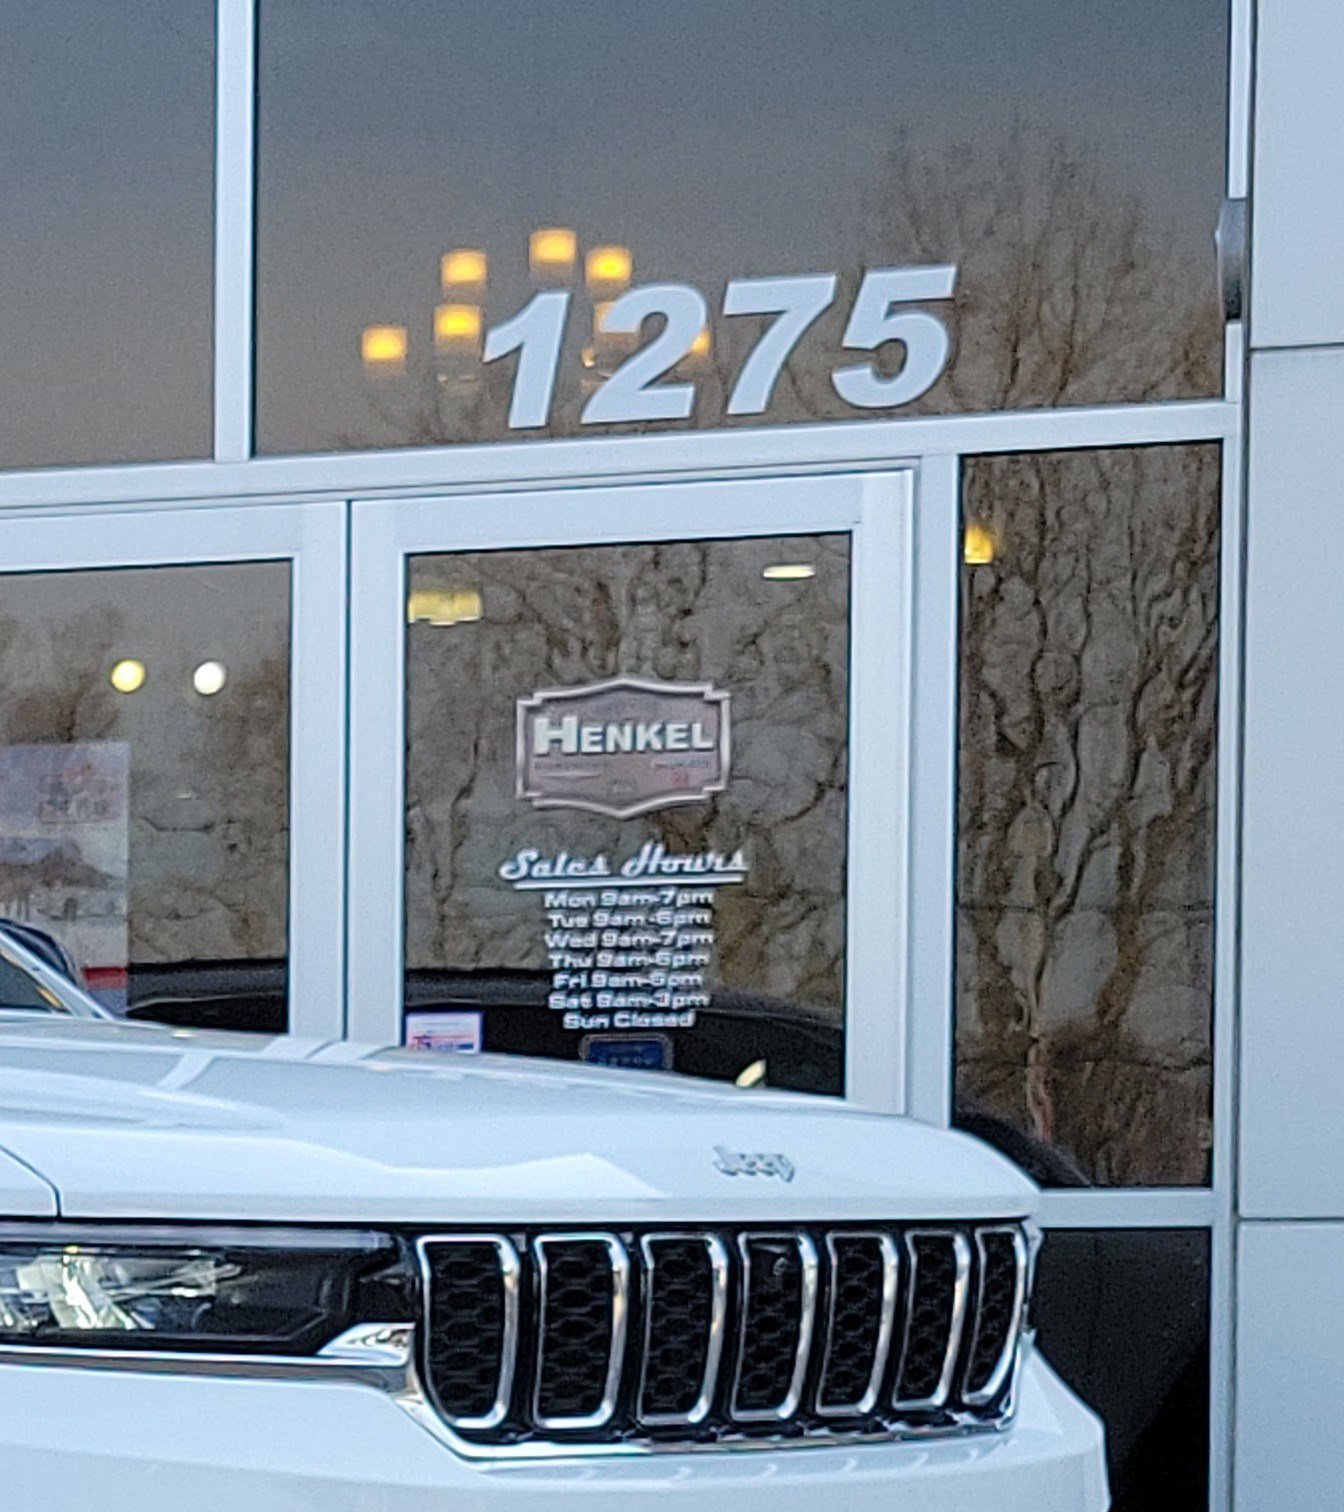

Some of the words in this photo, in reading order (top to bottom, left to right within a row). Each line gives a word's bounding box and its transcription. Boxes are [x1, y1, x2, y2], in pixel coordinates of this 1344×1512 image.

[482, 264, 957, 429] 1275
[532, 715, 715, 756] HENKEL
[499, 848, 610, 880] Sales
[621, 840, 749, 876] Hours
[544, 891, 596, 908] Mon
[548, 912, 590, 928] Tue
[544, 931, 598, 948] Wed
[548, 952, 594, 968] Thu
[553, 972, 588, 989] Fri
[548, 991, 593, 1010] Sat
[563, 1013, 610, 1029] Sun
[614, 1010, 696, 1028] Closed
[713, 1146, 795, 1183] Jeep
